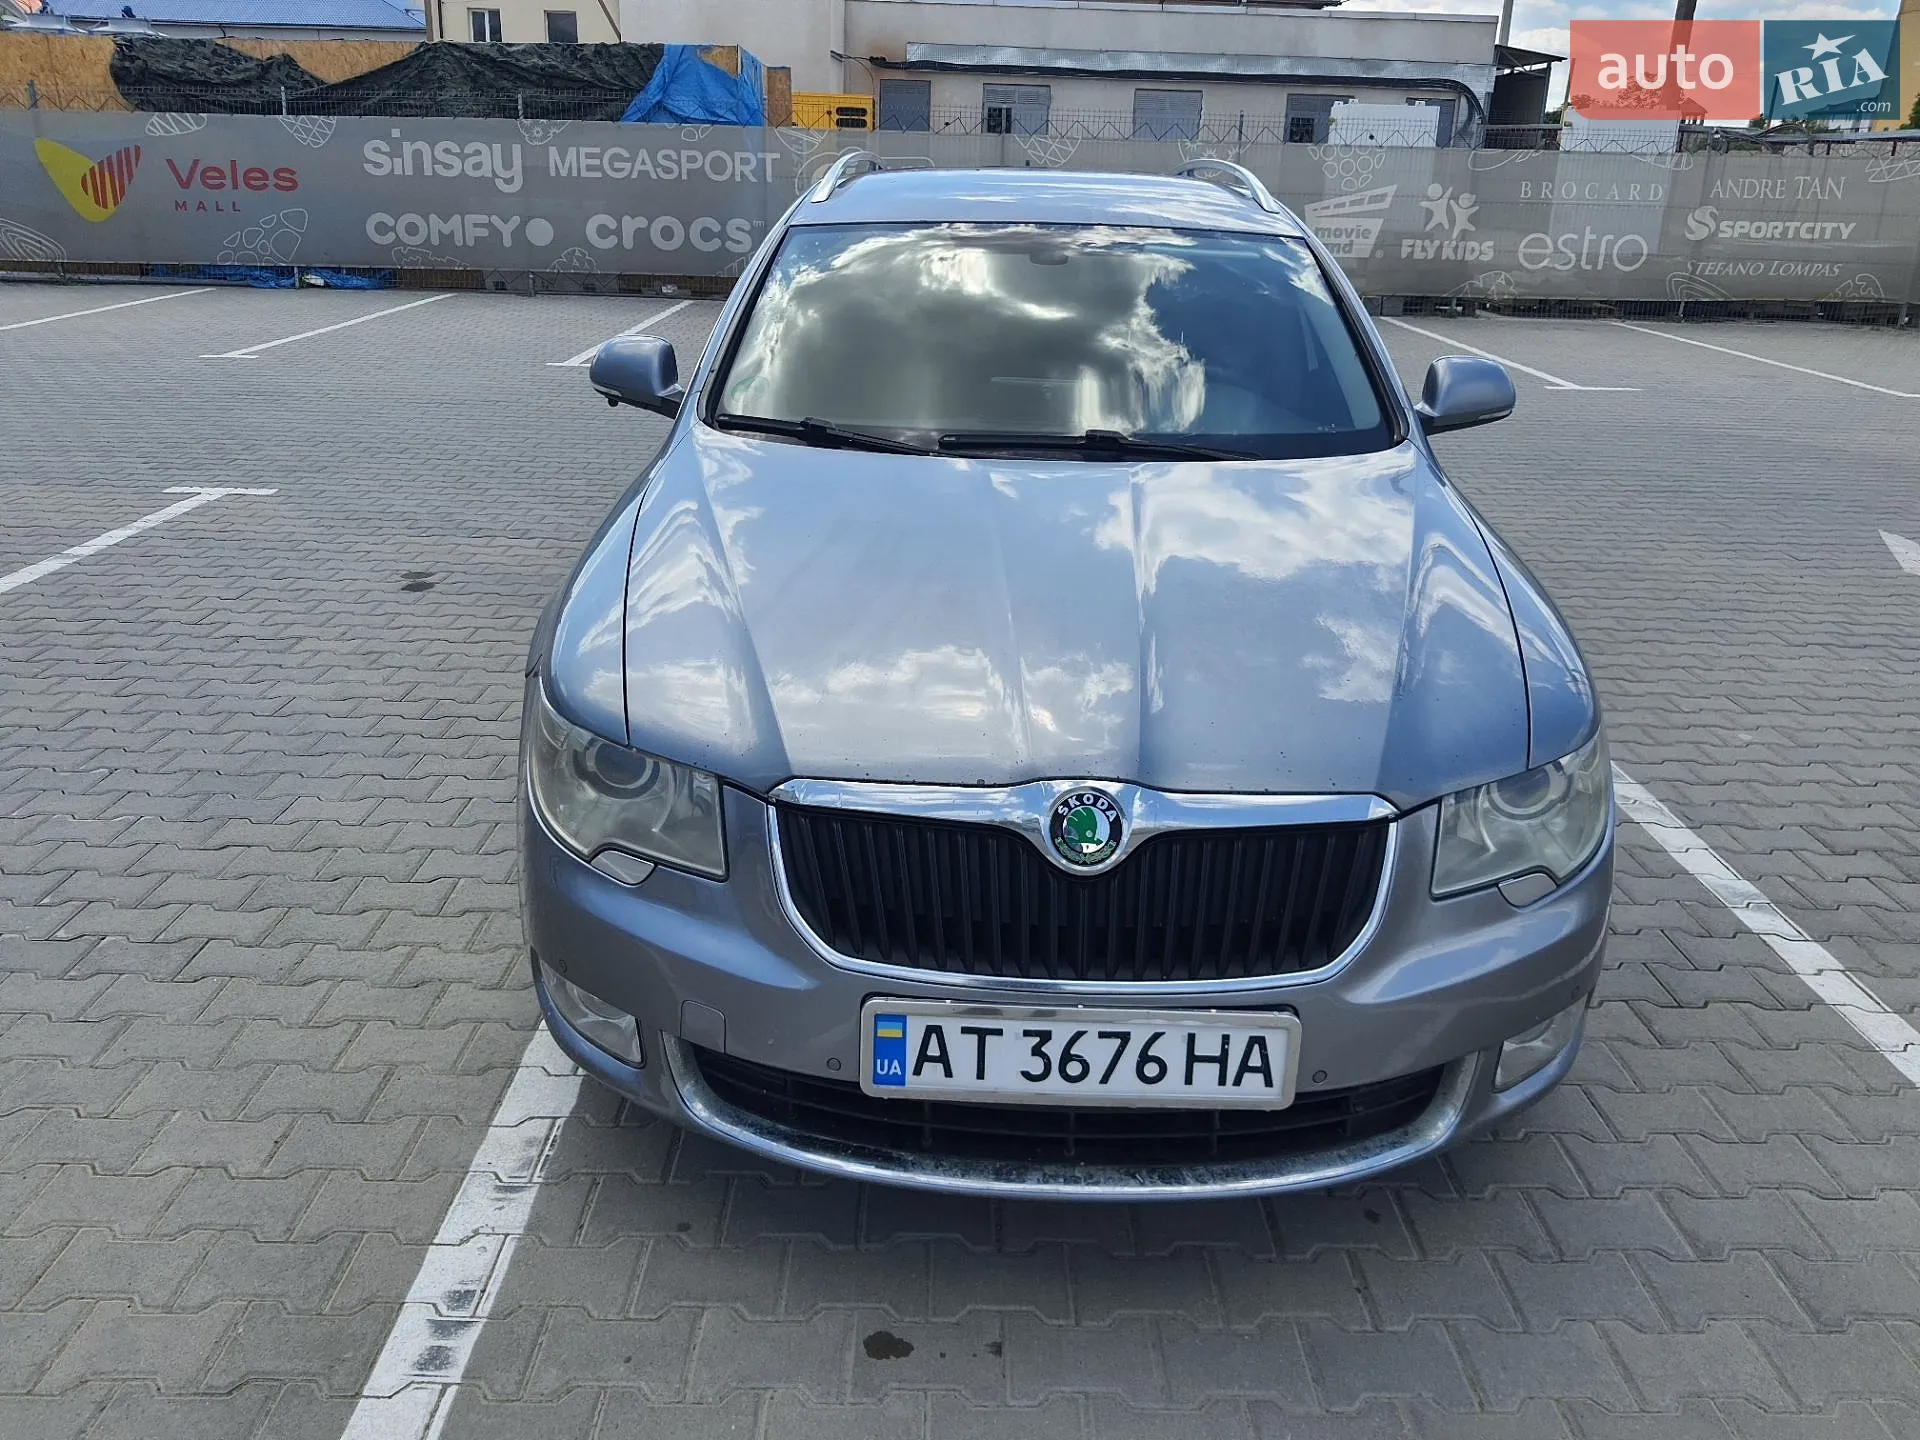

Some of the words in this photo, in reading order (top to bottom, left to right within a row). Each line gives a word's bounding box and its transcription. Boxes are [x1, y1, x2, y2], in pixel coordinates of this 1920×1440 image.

[363, 128, 523, 193] sinsay
[549, 146, 780, 183] MEGASPORT
[166, 158, 299, 192] Veles
[1710, 178, 1786, 199] ANDRE
[1795, 176, 1847, 199] TAN
[1520, 180, 1664, 201] BROCARD
[175, 199, 241, 213] MALL
[365, 212, 520, 247] COMFY
[1315, 224, 1372, 240] movie
[1717, 220, 1857, 240] SPORTCITY
[1518, 225, 1649, 272] estro
[1057, 793, 1117, 822] SKODA
[876, 1058, 902, 1075] UA
[912, 1024, 1004, 1080] AT
[1019, 1029, 1169, 1085] 3676
[1183, 1032, 1275, 1088] HA
